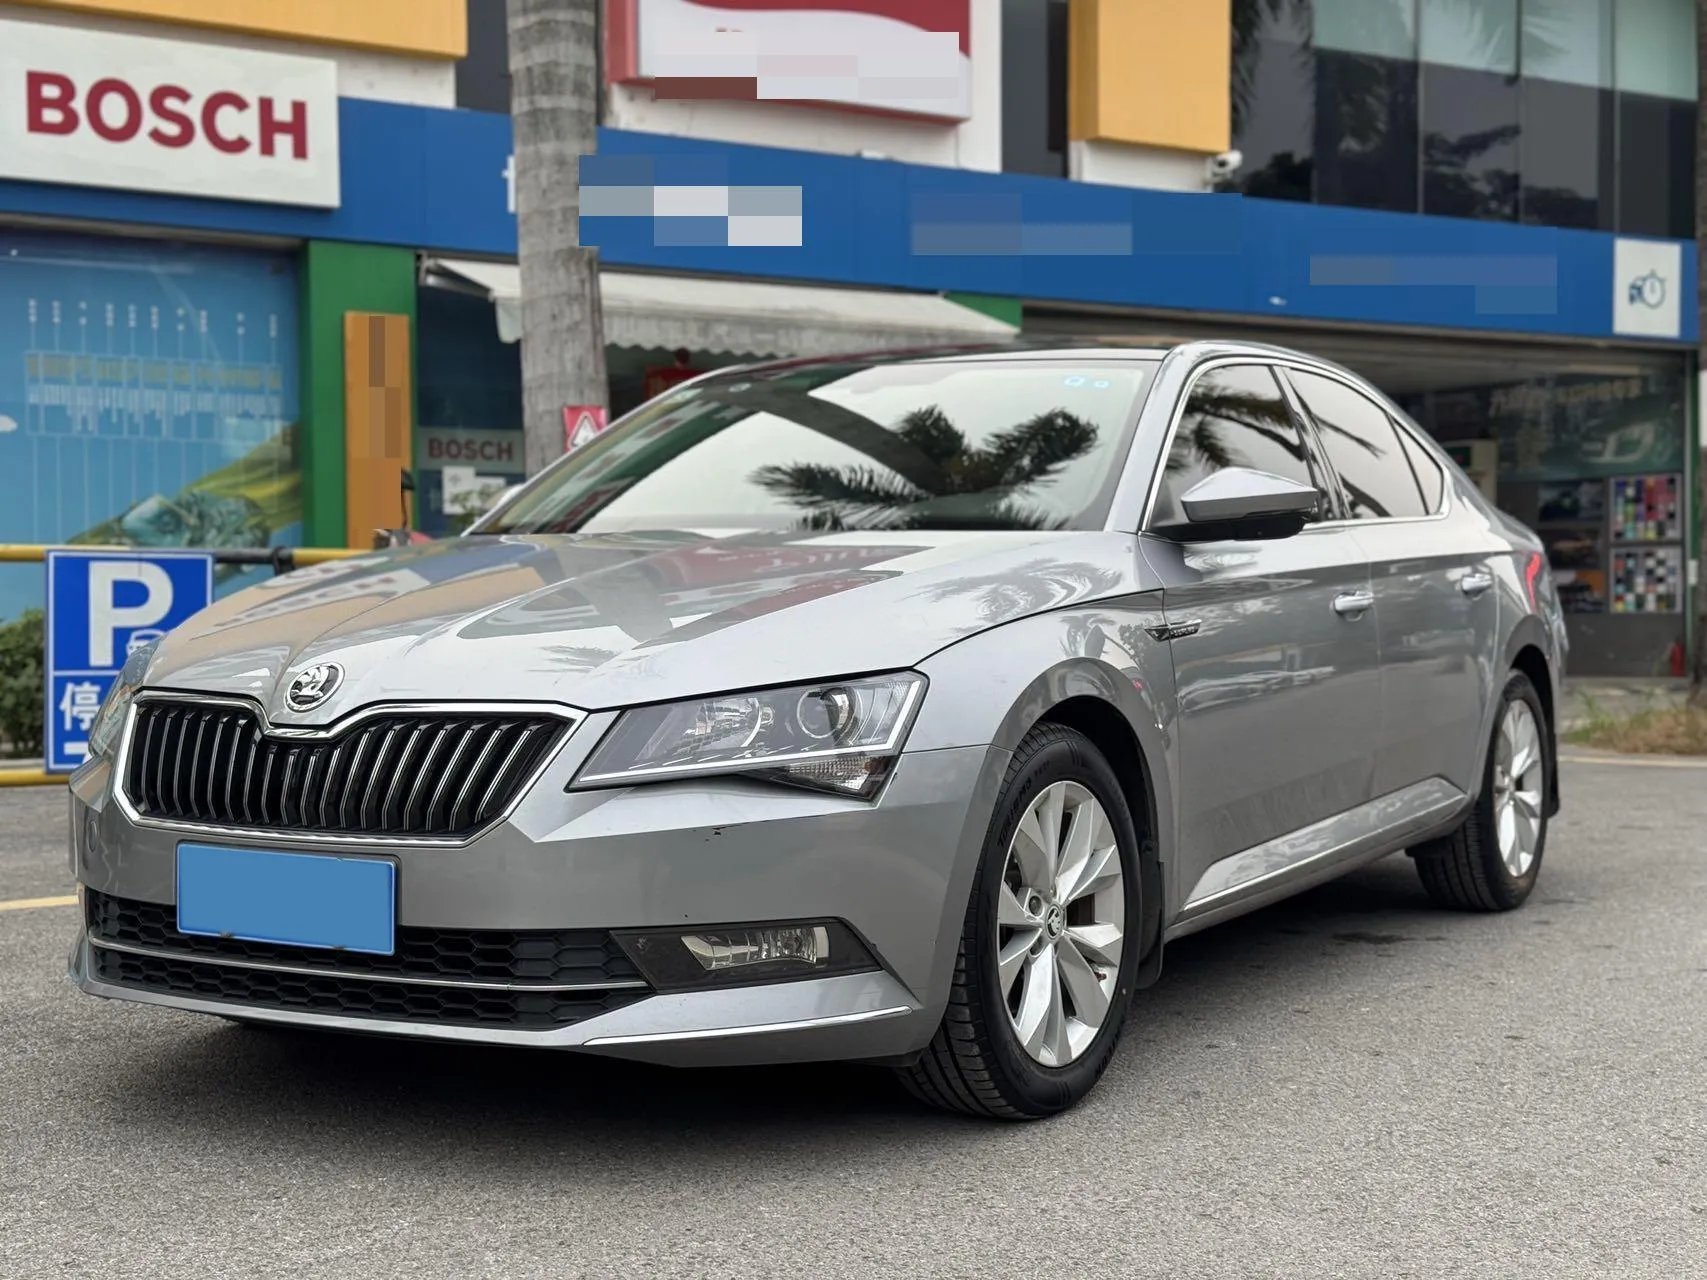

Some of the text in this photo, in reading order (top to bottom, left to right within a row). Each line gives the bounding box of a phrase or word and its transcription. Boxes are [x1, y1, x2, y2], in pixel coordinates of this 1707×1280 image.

[26, 70, 309, 160] BOSCH
[428, 438, 513, 461] BOSCH
[89, 561, 174, 667] P
